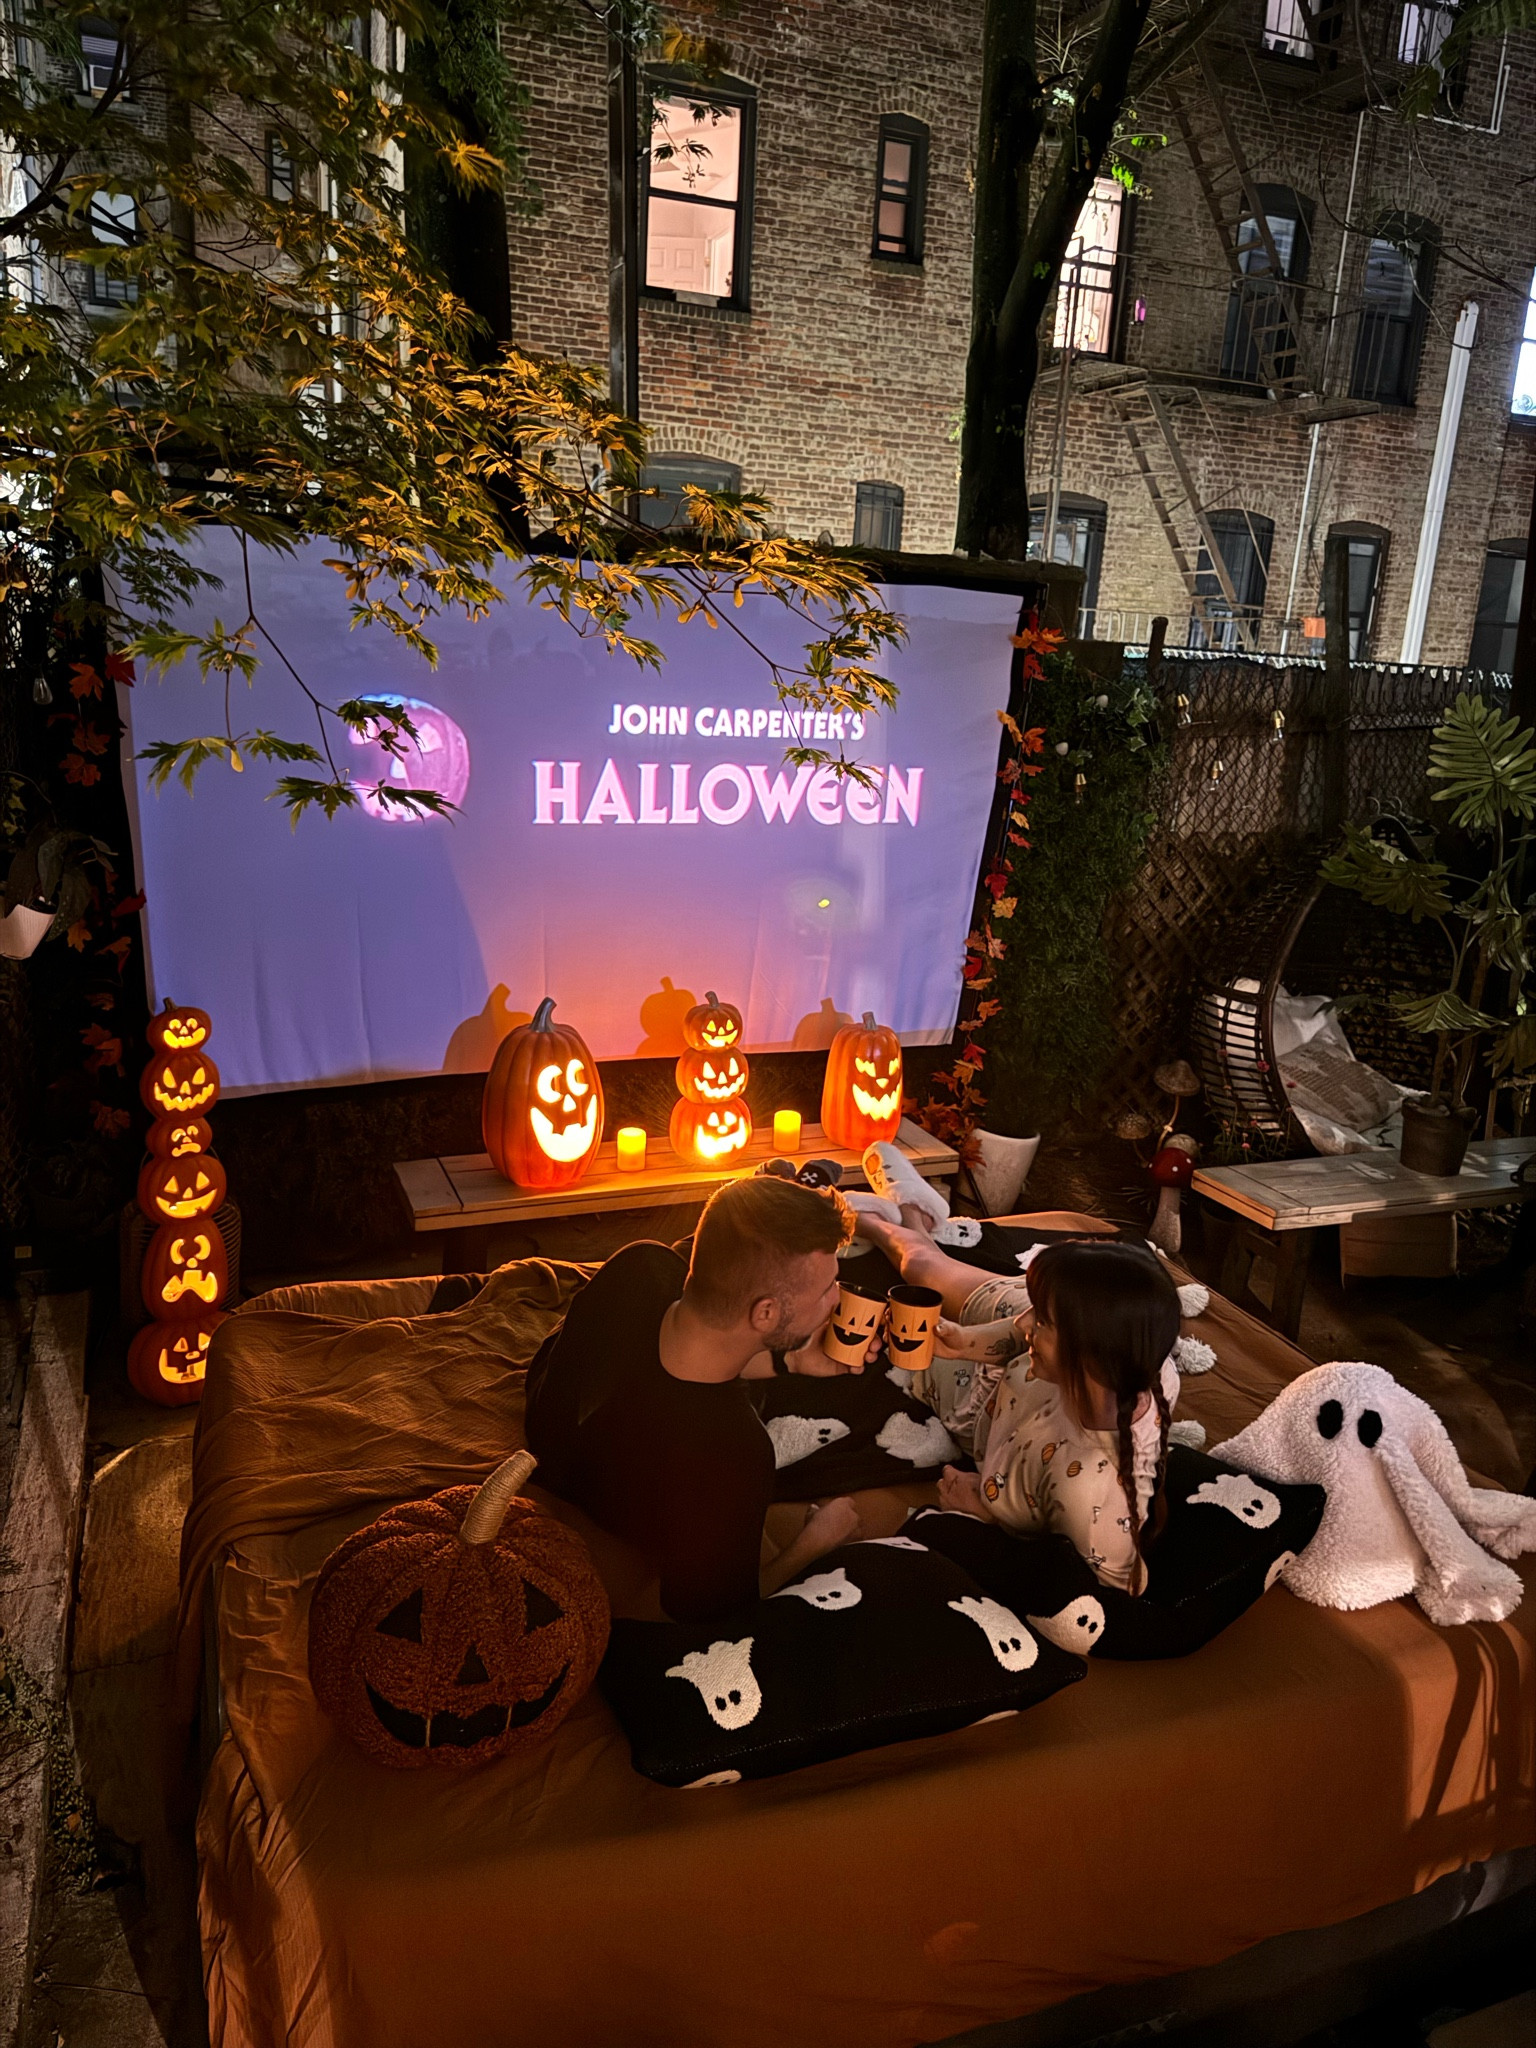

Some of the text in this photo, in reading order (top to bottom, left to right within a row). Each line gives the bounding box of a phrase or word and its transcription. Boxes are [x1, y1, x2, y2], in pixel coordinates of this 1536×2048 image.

[609, 704, 866, 740] JOHN CARPENTER'S
[532, 759, 925, 827] HALLOWEEN
